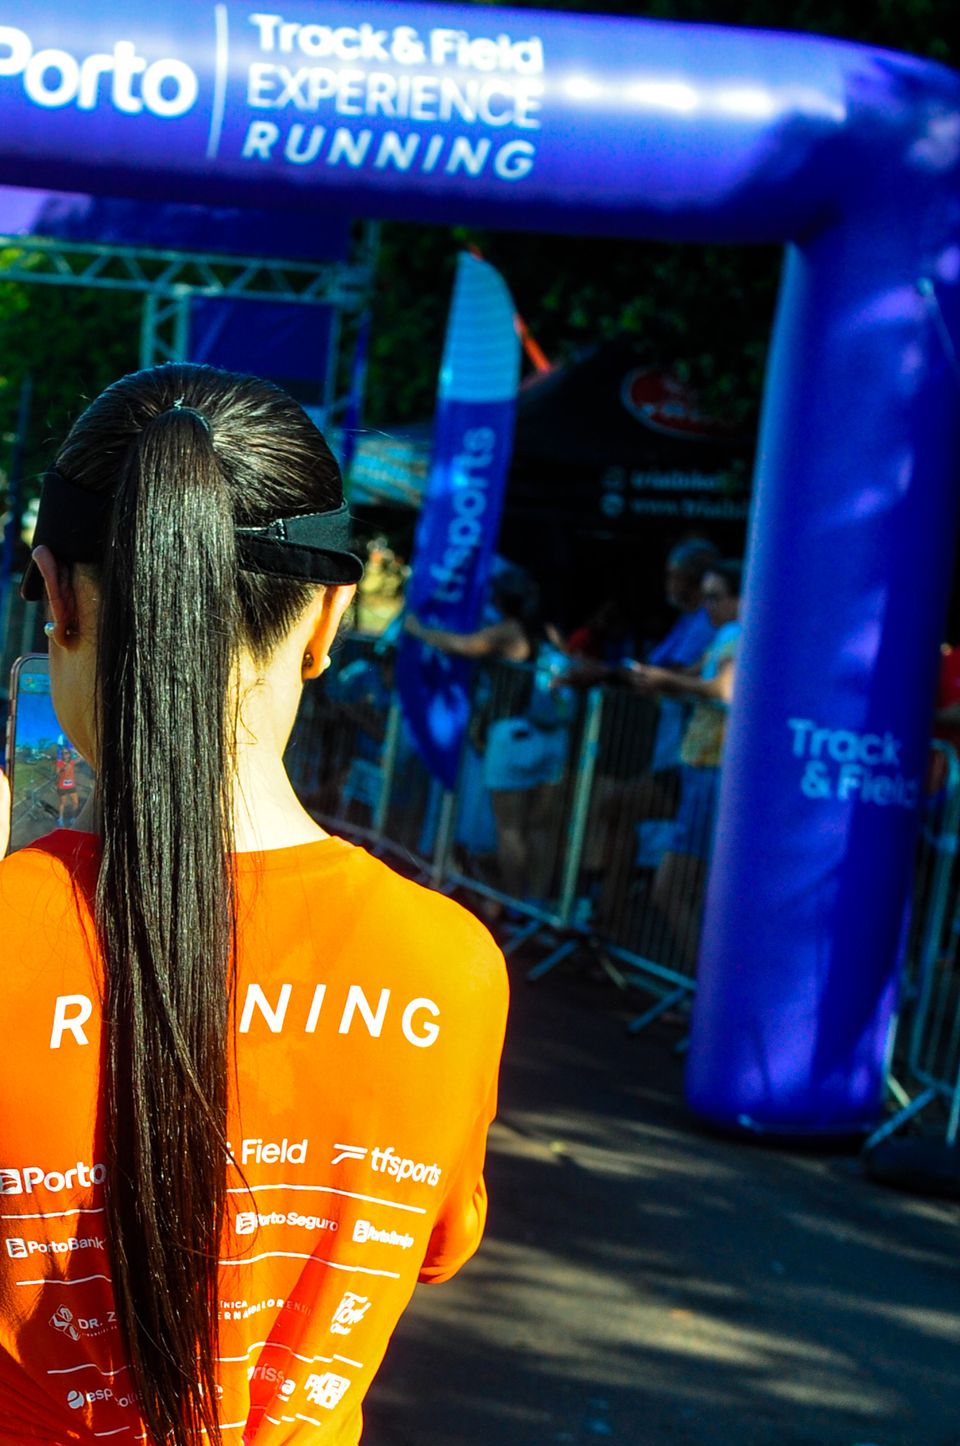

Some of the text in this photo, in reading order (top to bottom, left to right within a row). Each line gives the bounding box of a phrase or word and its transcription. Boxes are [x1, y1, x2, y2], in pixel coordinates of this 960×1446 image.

[250, 14, 388, 61] Track
[431, 30, 544, 74] Field
[247, 62, 544, 129] EXPERIENCE
[242, 121, 537, 181] RUNNING
[788, 718, 900, 768] Track
[801, 760, 831, 799] &
[50, 983, 441, 1048] RNING
[241, 1138, 308, 1164] Field
[371, 1147, 442, 1187] tfsports
[22, 1162, 107, 1194] Porto
[286, 1211, 340, 1232] Seguro
[27, 1237, 105, 1254] PortoBank
